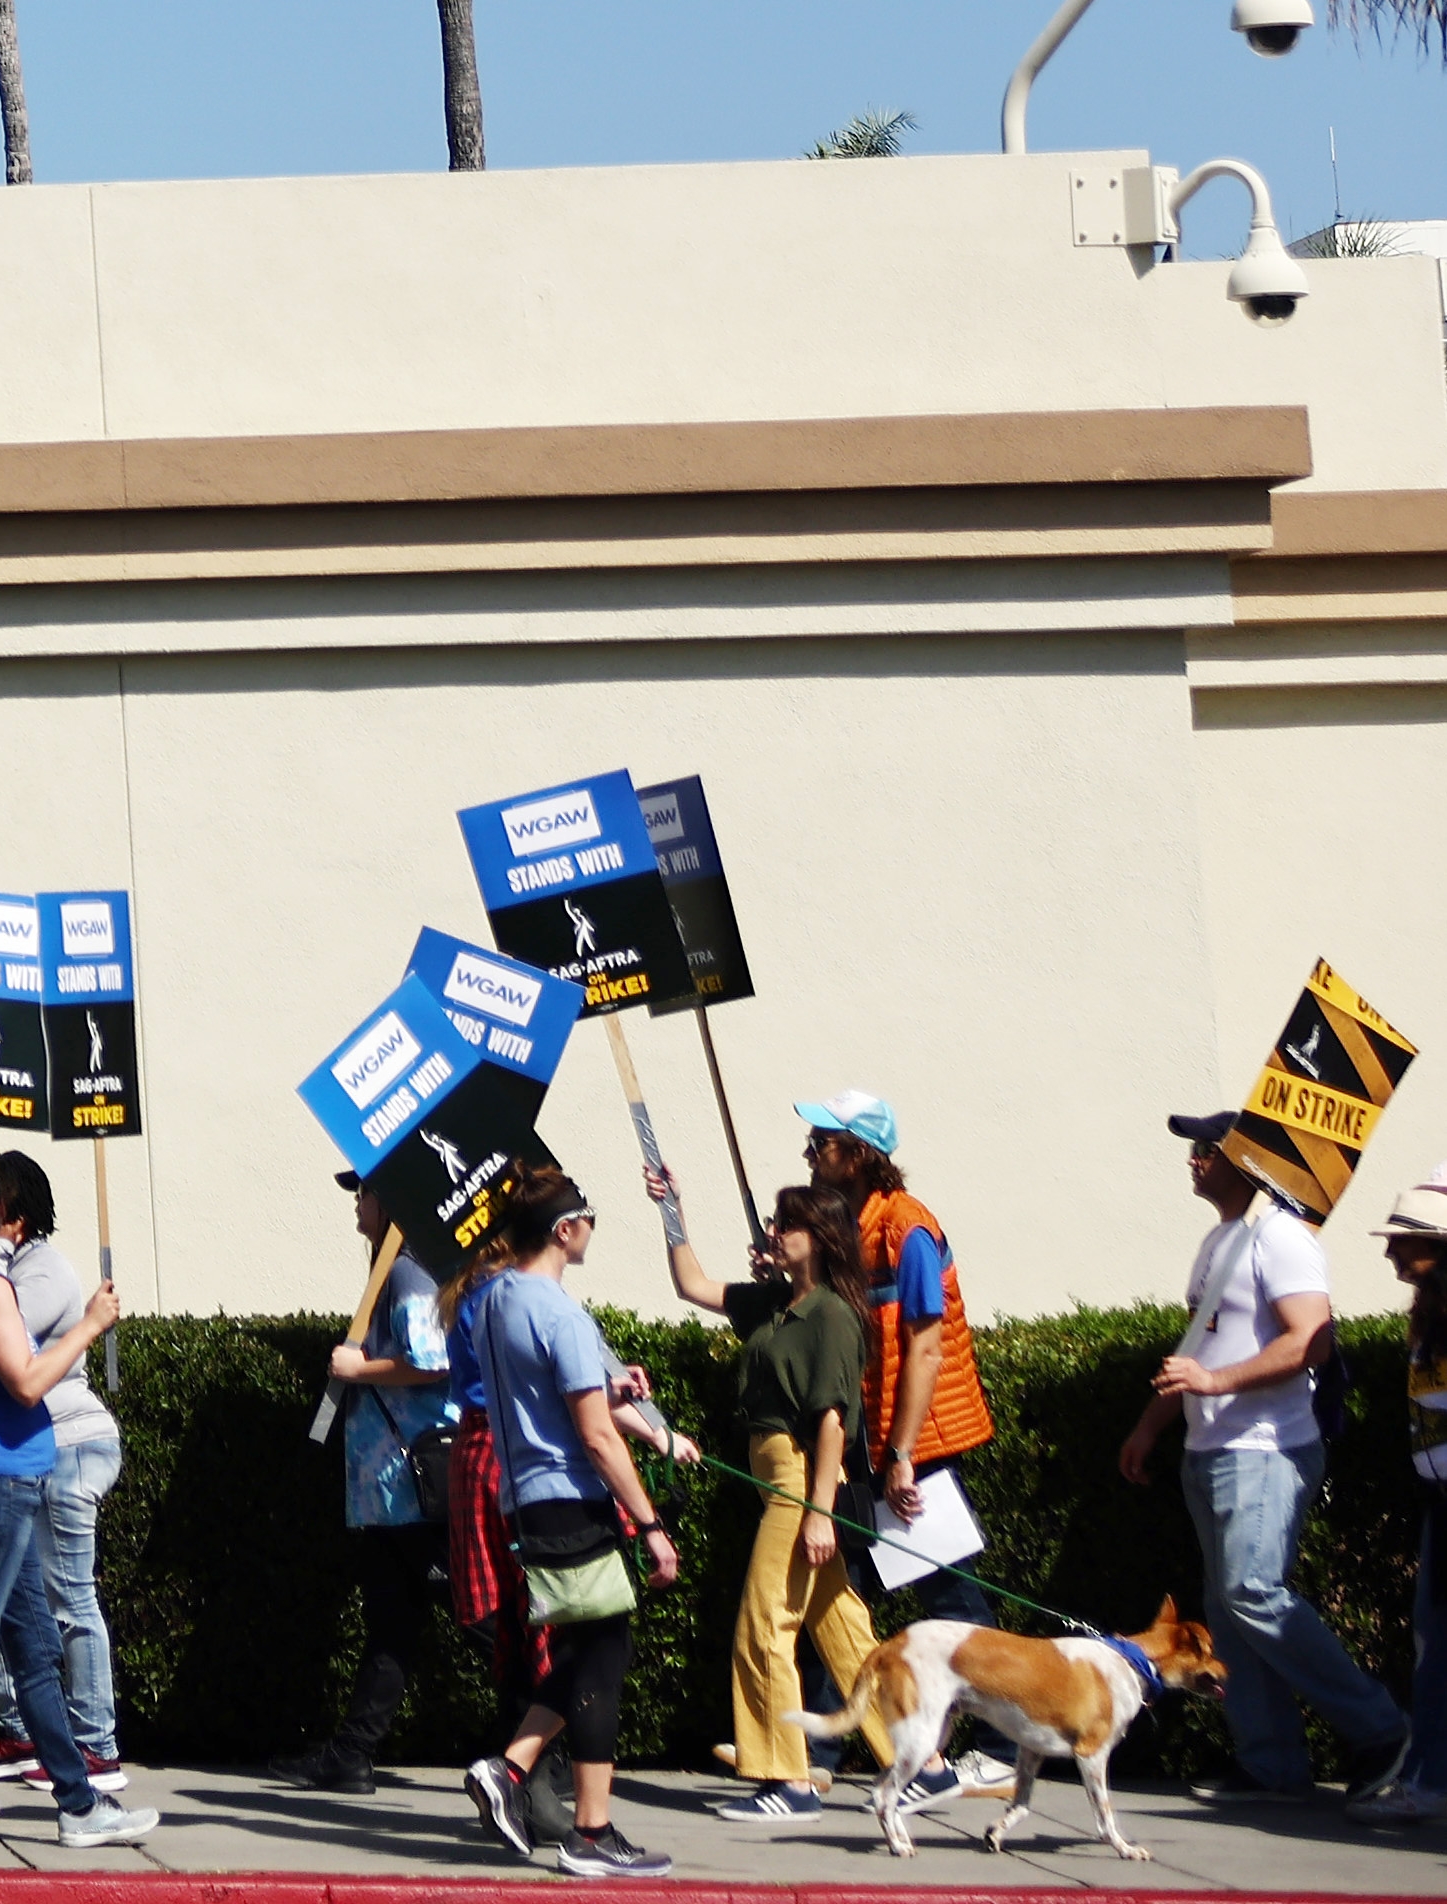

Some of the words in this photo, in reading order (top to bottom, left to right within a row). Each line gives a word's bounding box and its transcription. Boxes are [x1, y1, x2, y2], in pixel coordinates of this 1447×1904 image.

[510, 806, 589, 840] WGAW
[644, 808, 677, 830] GAW
[506, 856, 575, 894] STANDS
[574, 842, 625, 877] WITH
[669, 847, 700, 874] WITH
[65, 919, 108, 937] WGAW
[57, 964, 97, 993] STANDS
[98, 963, 123, 991] WITH
[455, 966, 532, 1009] WGAW
[585, 974, 650, 1007] RIKE!
[587, 972, 608, 987] ON
[344, 1028, 405, 1092] WGAW
[487, 1027, 534, 1065] WITH
[72, 1104, 125, 1128] STRIKE!
[360, 1085, 419, 1148] STANDS
[408, 1051, 454, 1100] WITH
[1261, 1075, 1292, 1115] ON
[1294, 1088, 1367, 1141] STRIKE
[472, 1190, 490, 1208] ON
